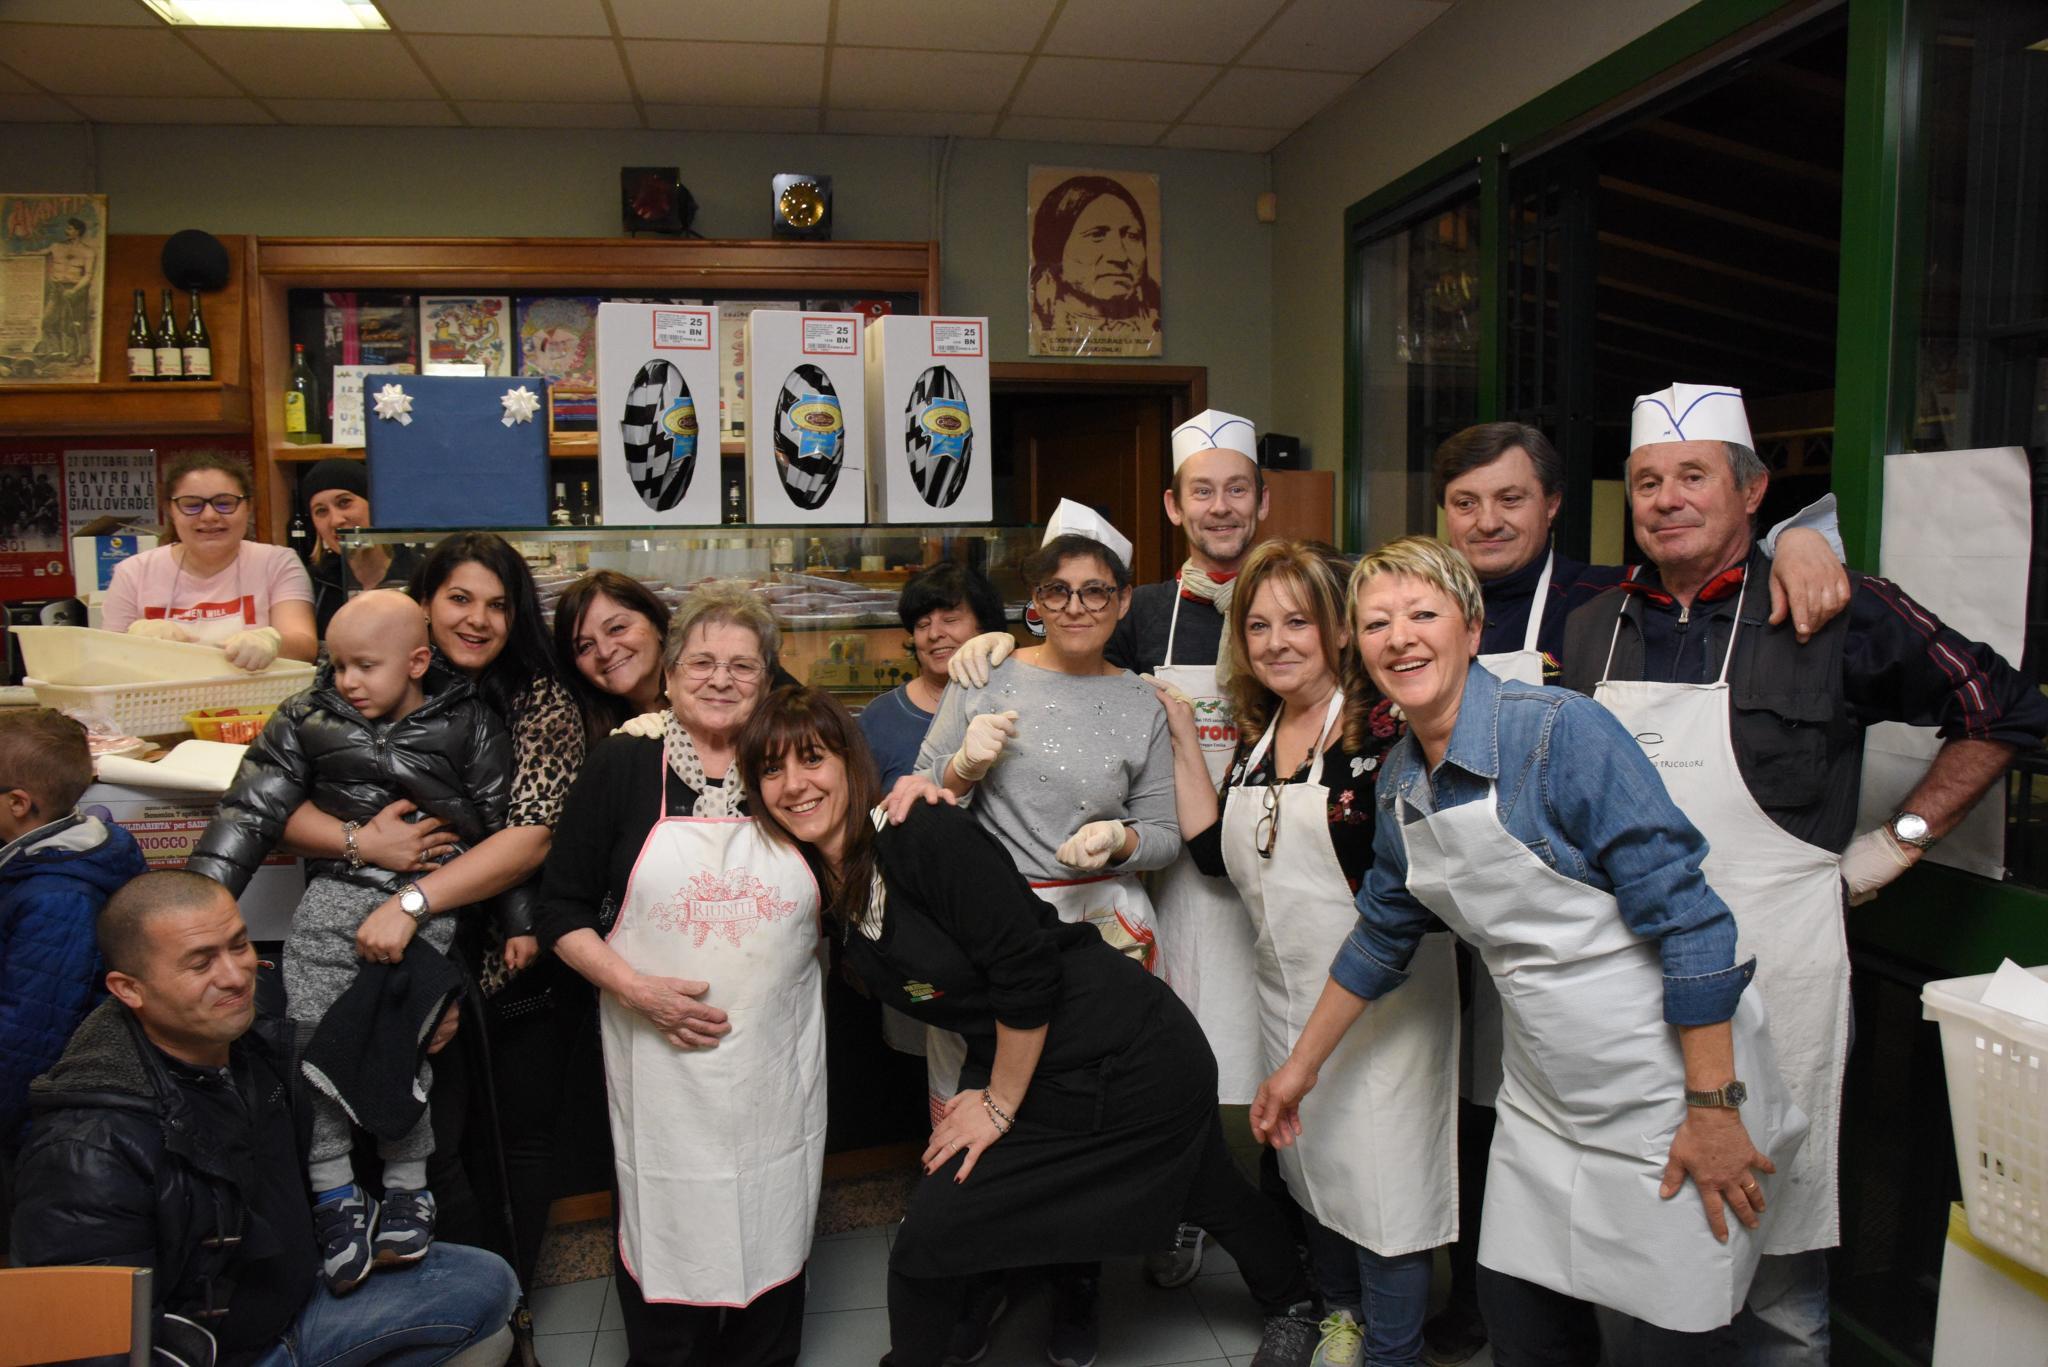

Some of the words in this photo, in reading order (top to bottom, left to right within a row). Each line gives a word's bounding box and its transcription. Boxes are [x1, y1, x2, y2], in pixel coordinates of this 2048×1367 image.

[690, 318, 703, 327] 25
[689, 328, 702, 336] BN
[836, 326, 849, 335] 25
[963, 328, 976, 336] 25
[83, 455, 129, 467] OTTOBRE
[68, 471, 129, 484] CONTRO
[140, 471, 154, 484] IL
[69, 484, 154, 497] GOVERNO
[69, 498, 155, 511] GIALLOVERDE!
[1197, 725, 1239, 741] ron
[173, 822, 186, 832] per
[138, 836, 188, 850] NOCCO
[693, 900, 757, 917] RIUNITE
